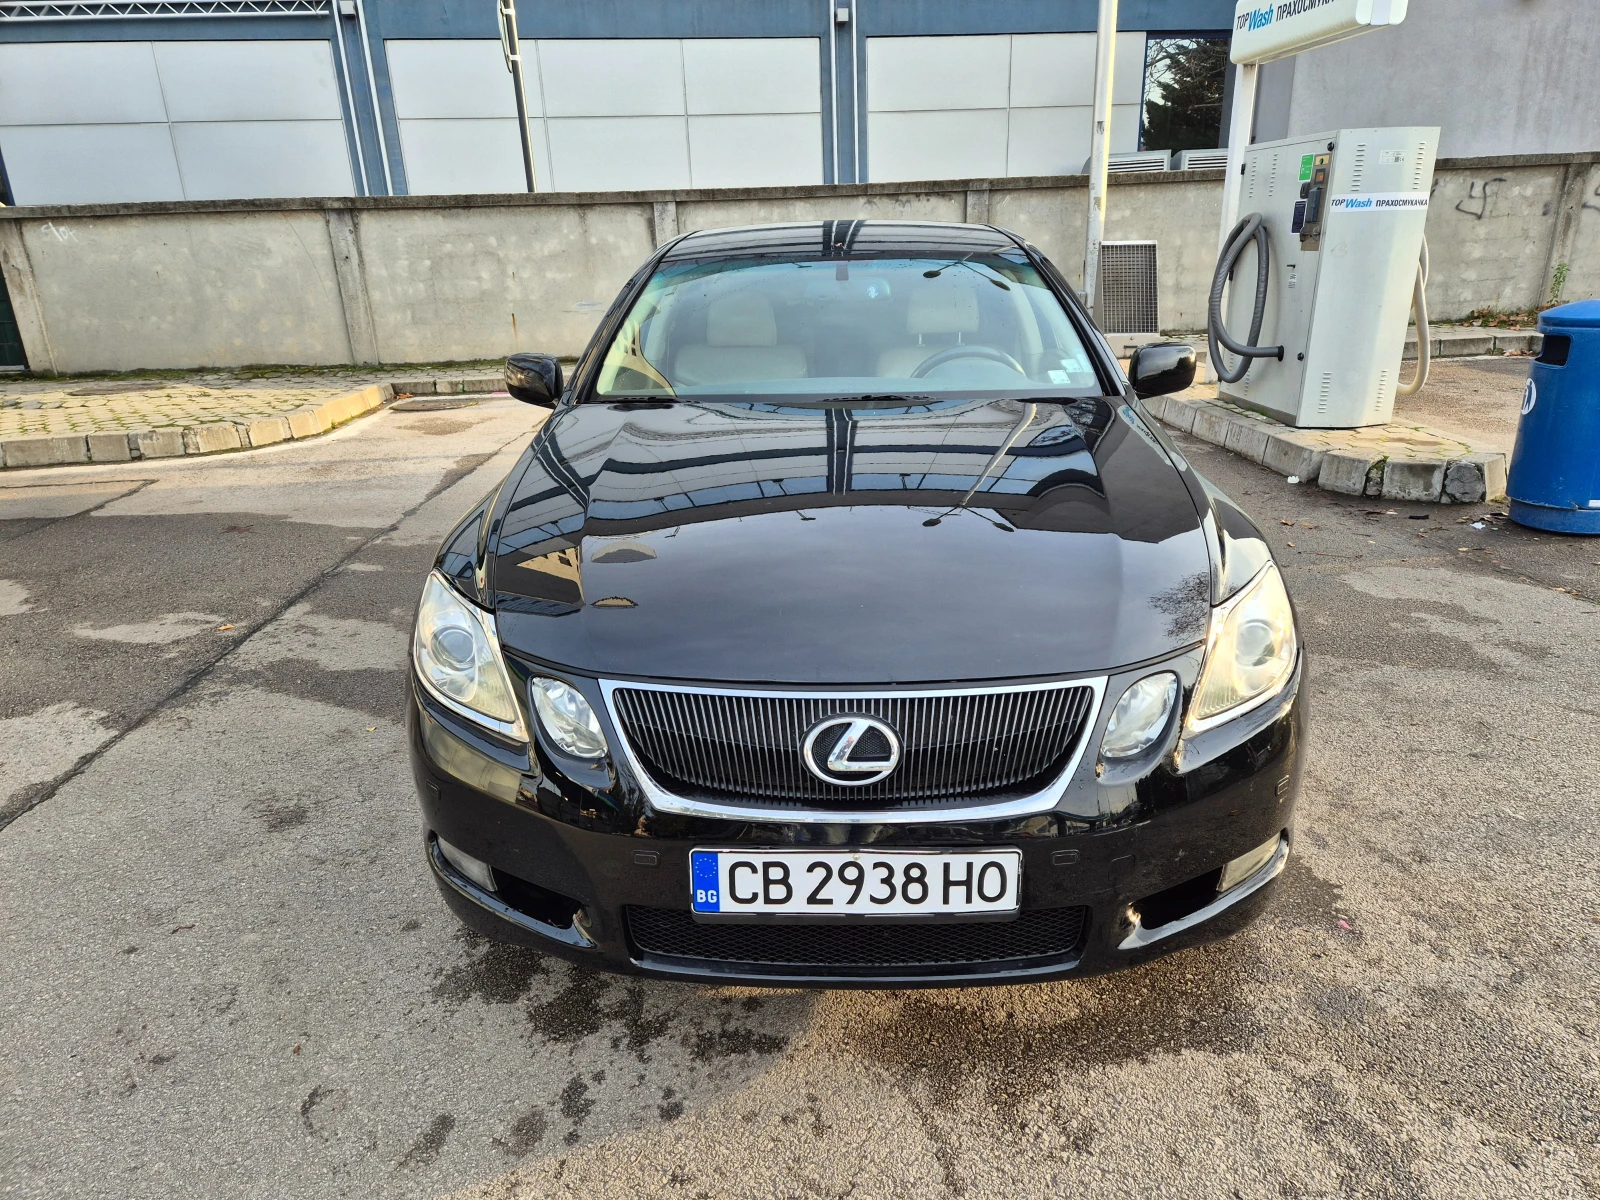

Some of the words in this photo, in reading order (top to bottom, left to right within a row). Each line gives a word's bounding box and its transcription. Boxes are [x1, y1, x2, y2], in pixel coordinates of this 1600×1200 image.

[1376, 199, 1428, 207] ПРАХОСМУКАЧКА
[728, 860, 794, 905] CB
[806, 860, 929, 905] 2938
[696, 889, 718, 903] BG
